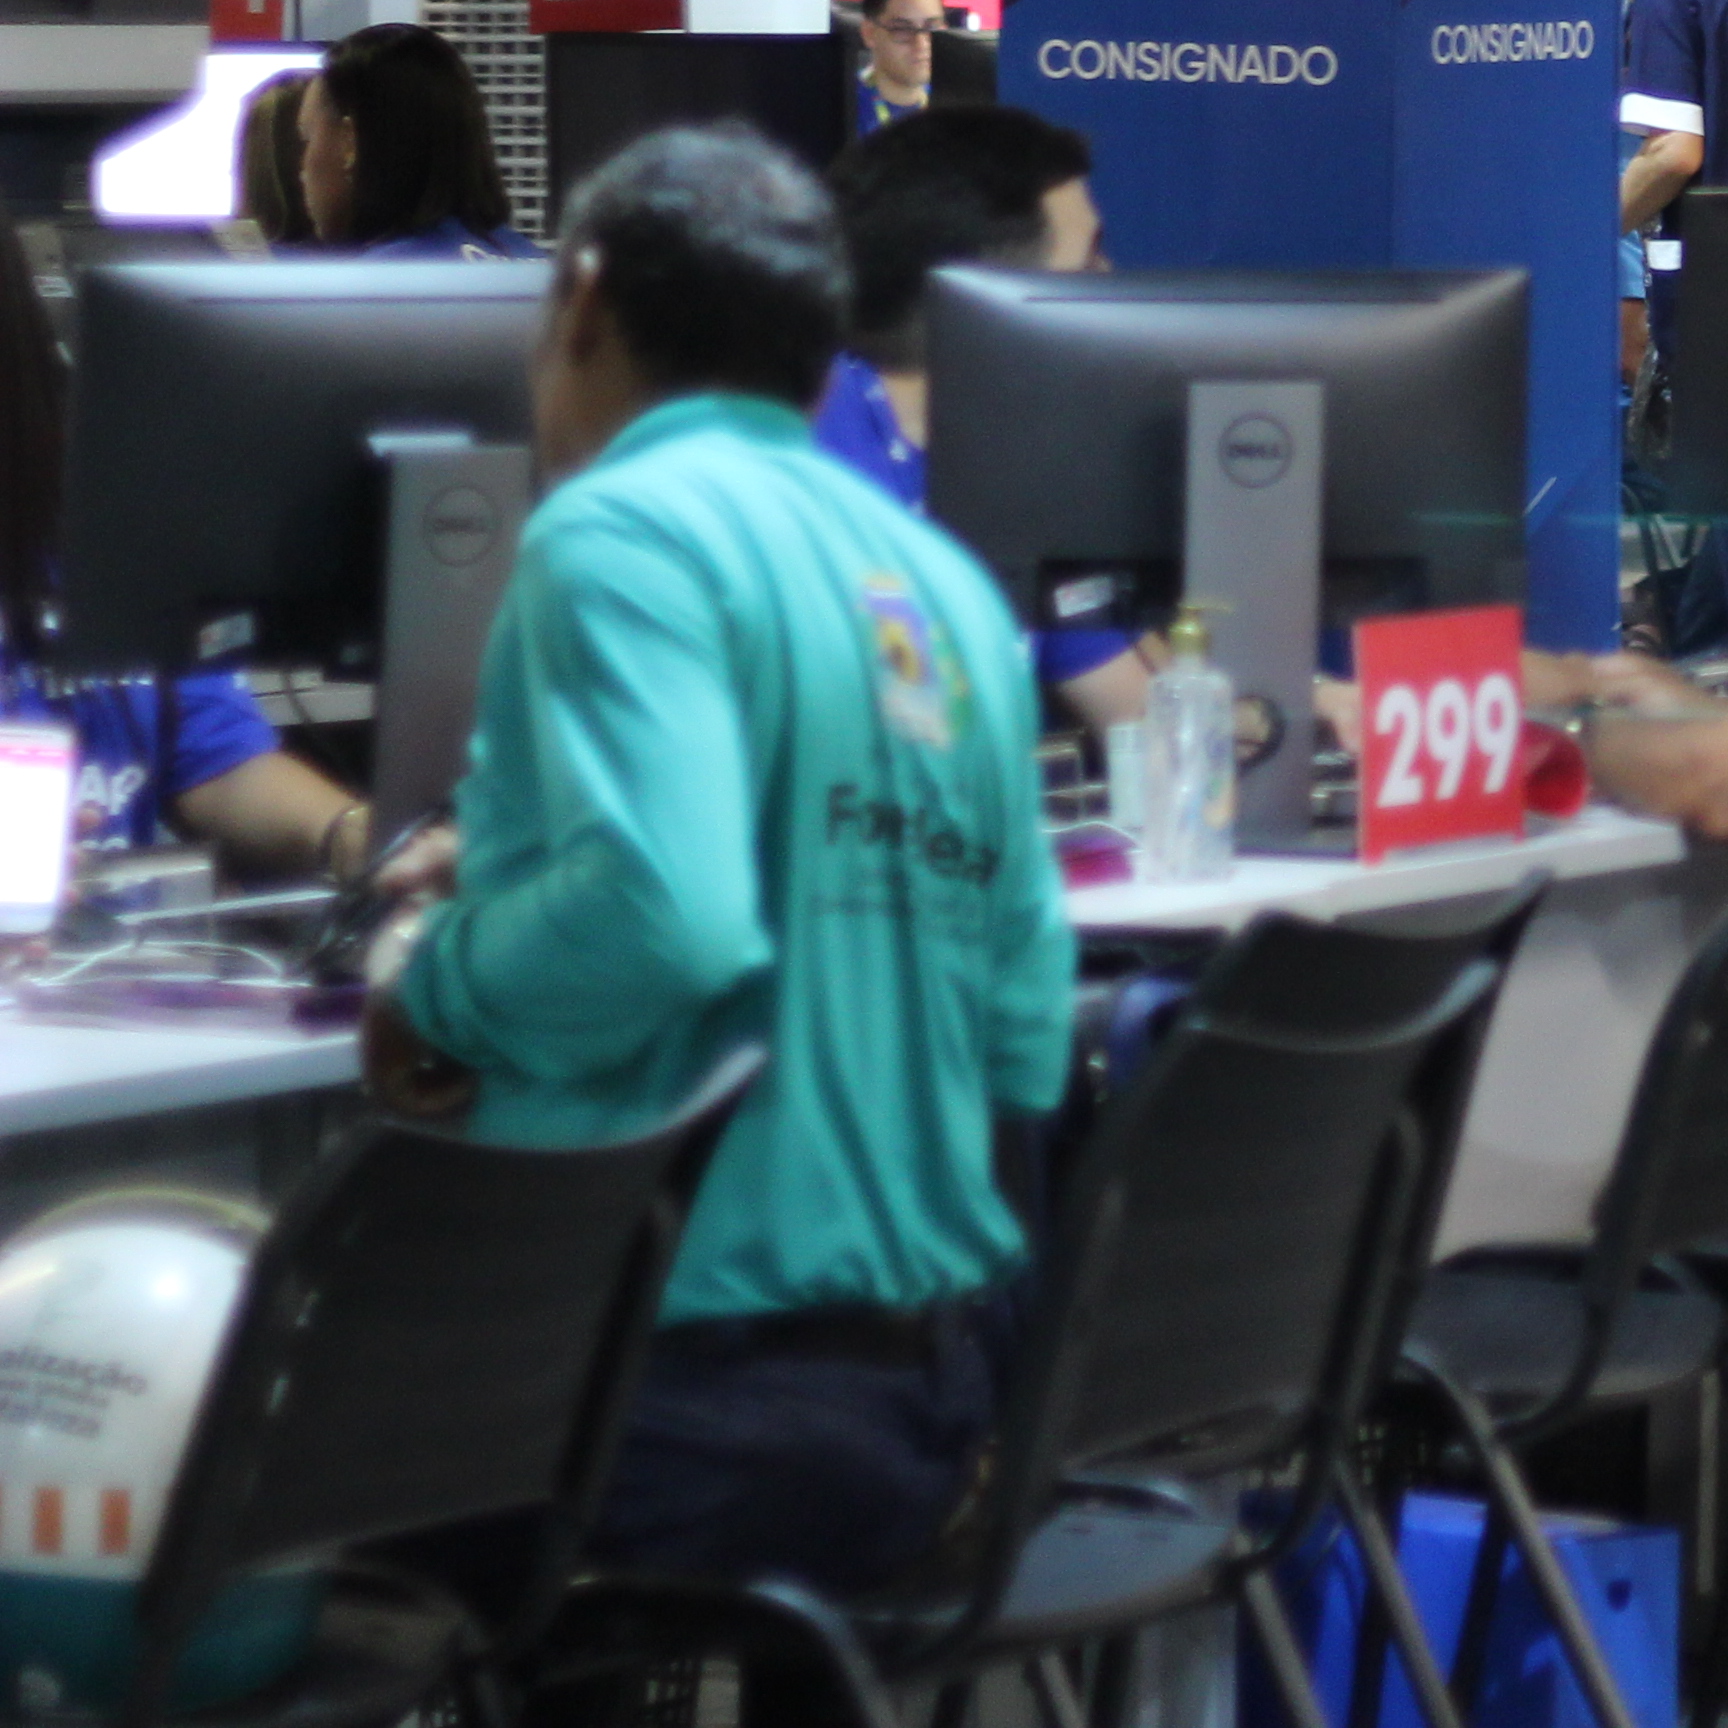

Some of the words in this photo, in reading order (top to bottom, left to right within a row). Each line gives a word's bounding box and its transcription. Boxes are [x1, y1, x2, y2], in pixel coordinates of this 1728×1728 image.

[1038, 38, 1338, 86] CONSIGNADO
[1431, 19, 1594, 64] CONSIGNADO
[1375, 674, 1520, 808] 299
